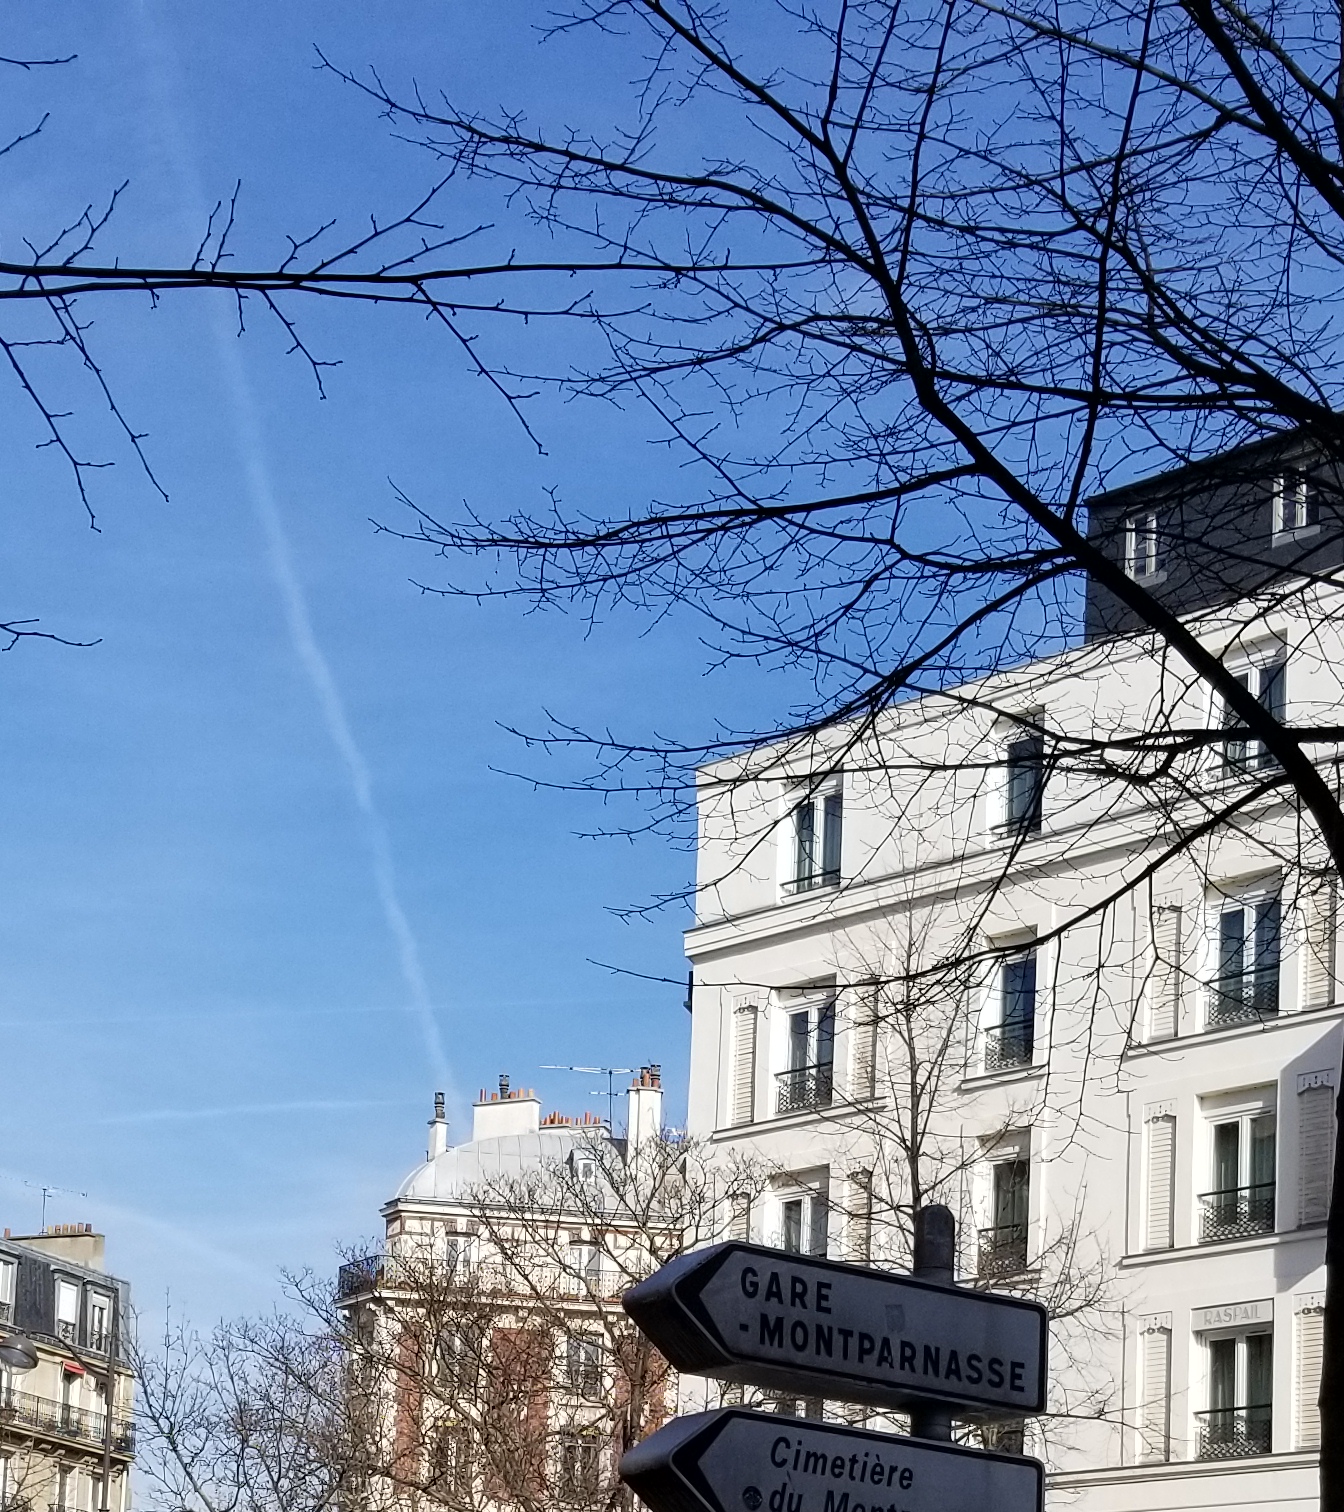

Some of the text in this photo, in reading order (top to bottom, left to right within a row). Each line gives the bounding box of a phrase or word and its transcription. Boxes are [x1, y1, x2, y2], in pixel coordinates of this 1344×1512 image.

[740, 1266, 833, 1315] GARE
[1203, 1303, 1262, 1326] RASPAIL
[769, 1435, 915, 1490] Cimetière
